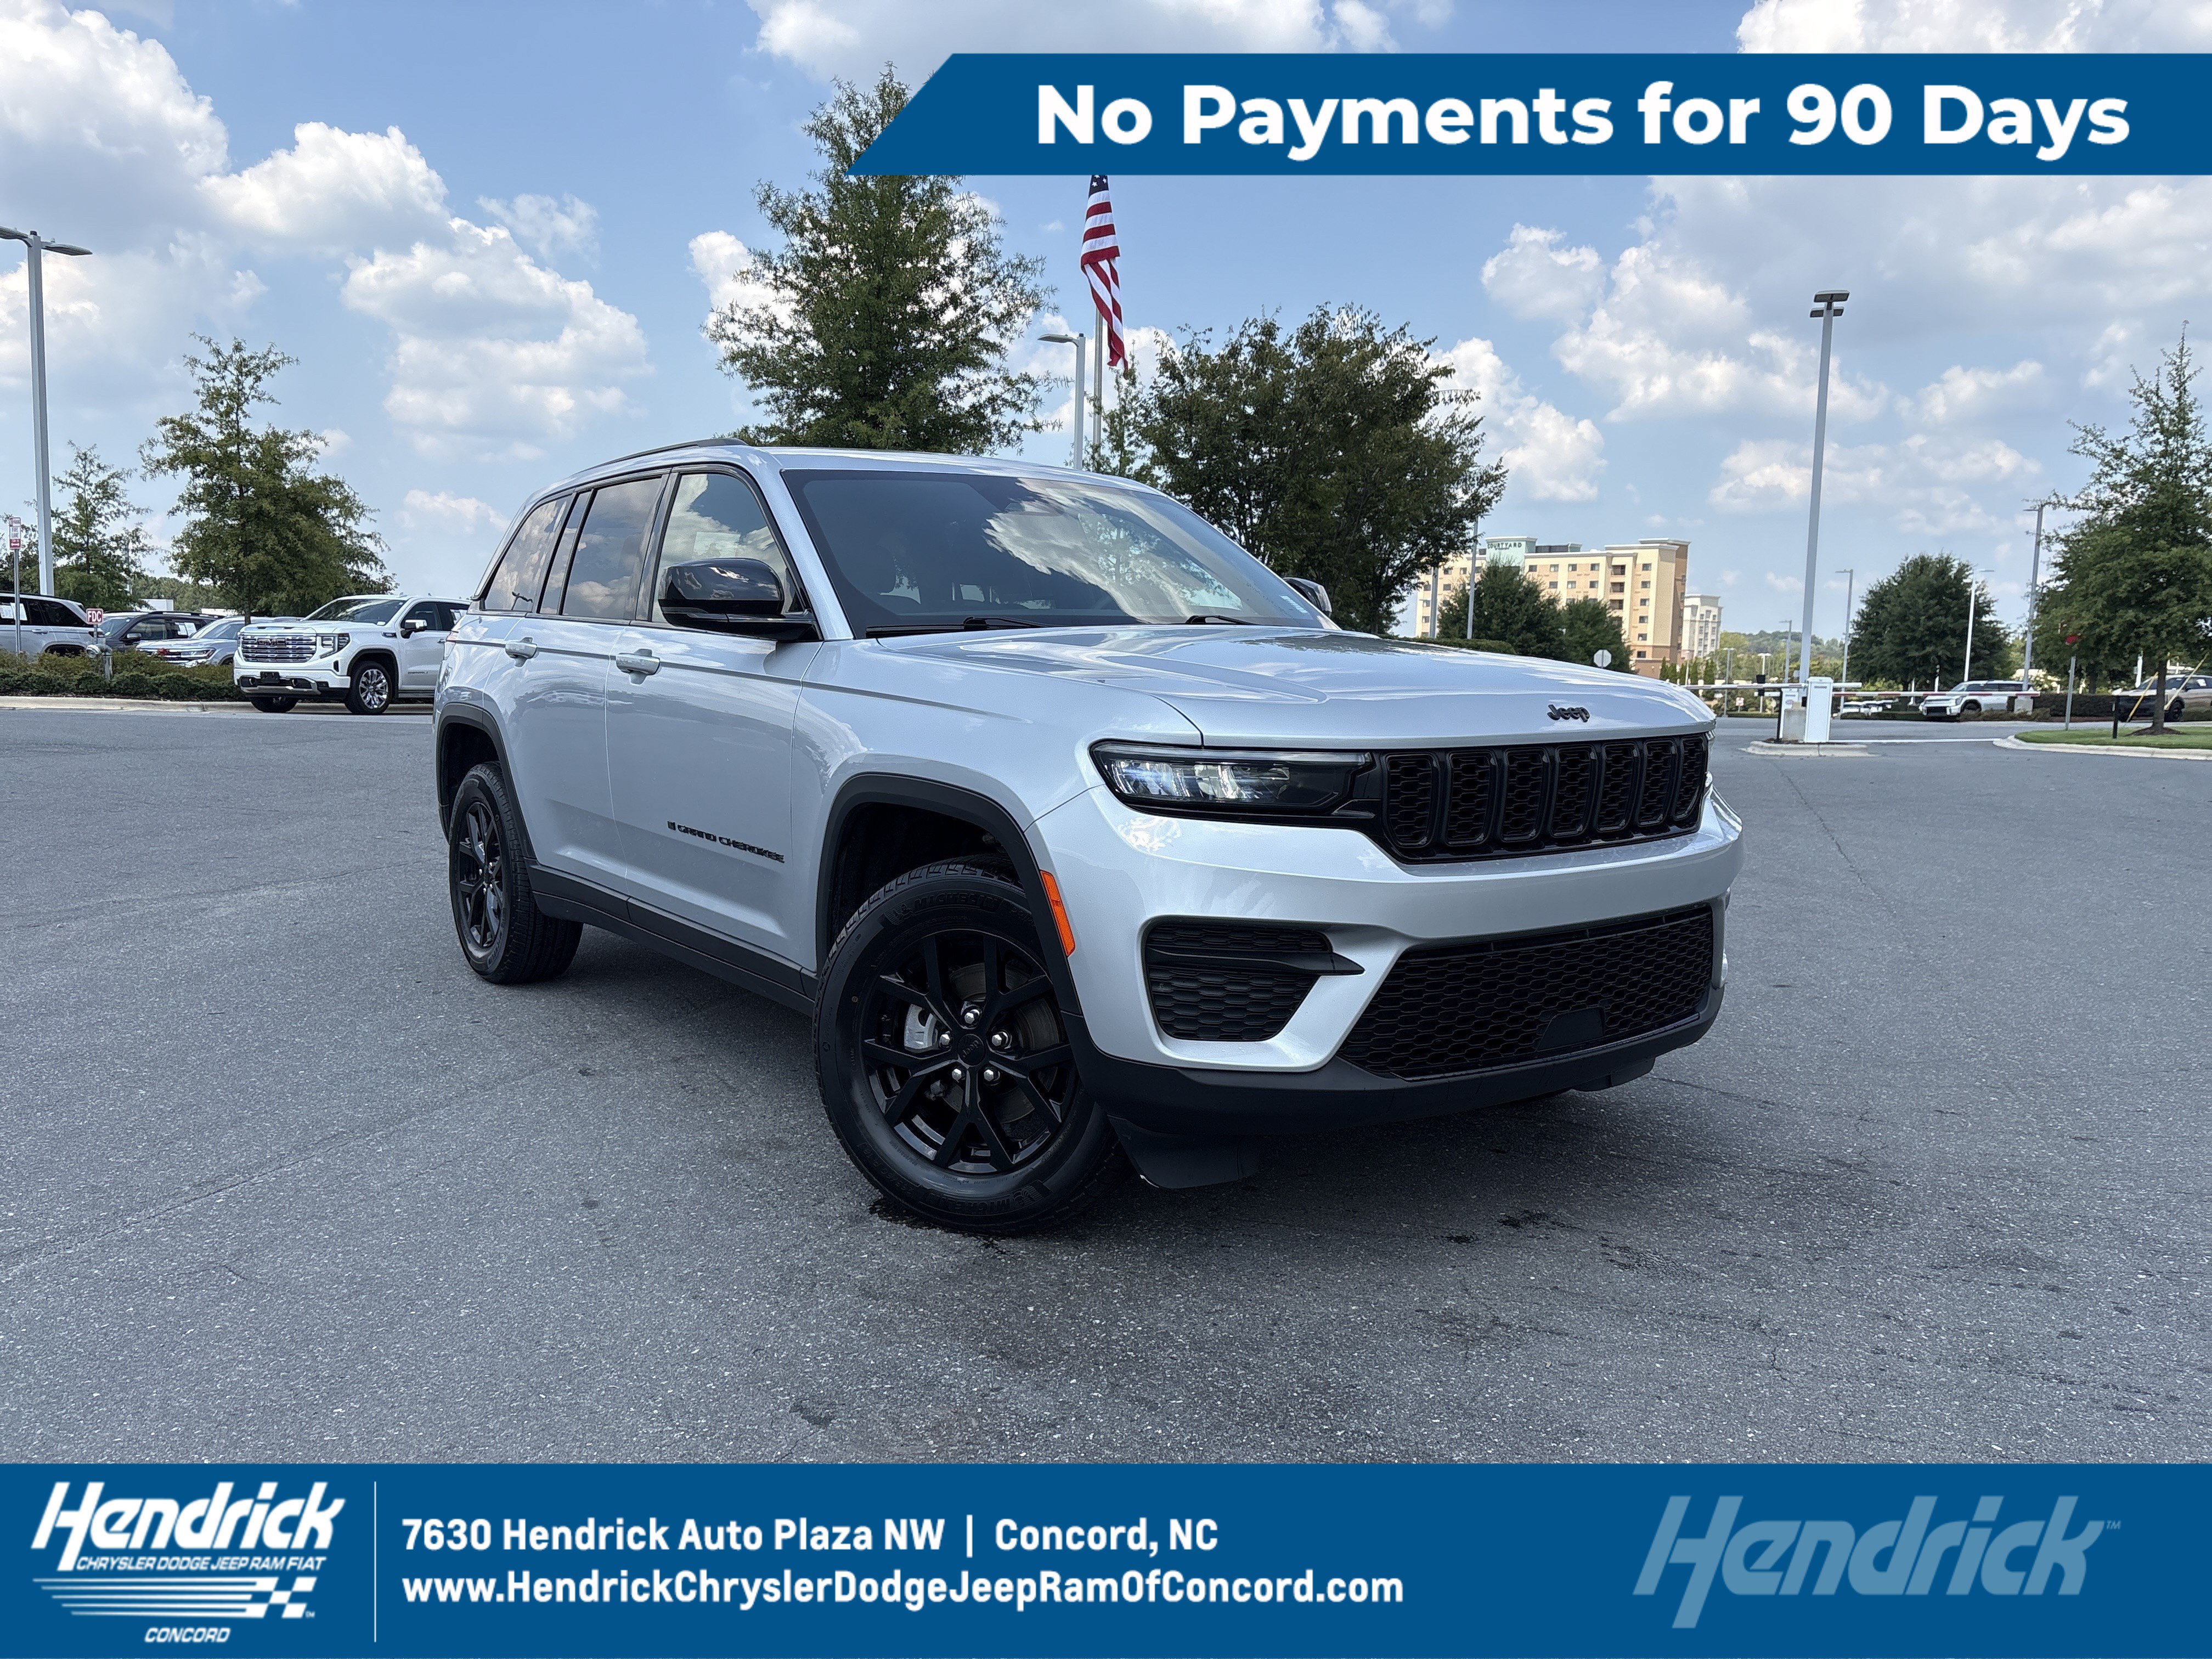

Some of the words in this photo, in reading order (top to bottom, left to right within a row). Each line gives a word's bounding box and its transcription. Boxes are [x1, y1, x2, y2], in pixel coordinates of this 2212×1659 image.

[88, 611, 101, 622] FDC
[1547, 704, 1590, 723] Jeep
[677, 824, 717, 842] GRAND
[718, 836, 786, 864] CHEROKEE
[914, 891, 1001, 913] MICHELIN
